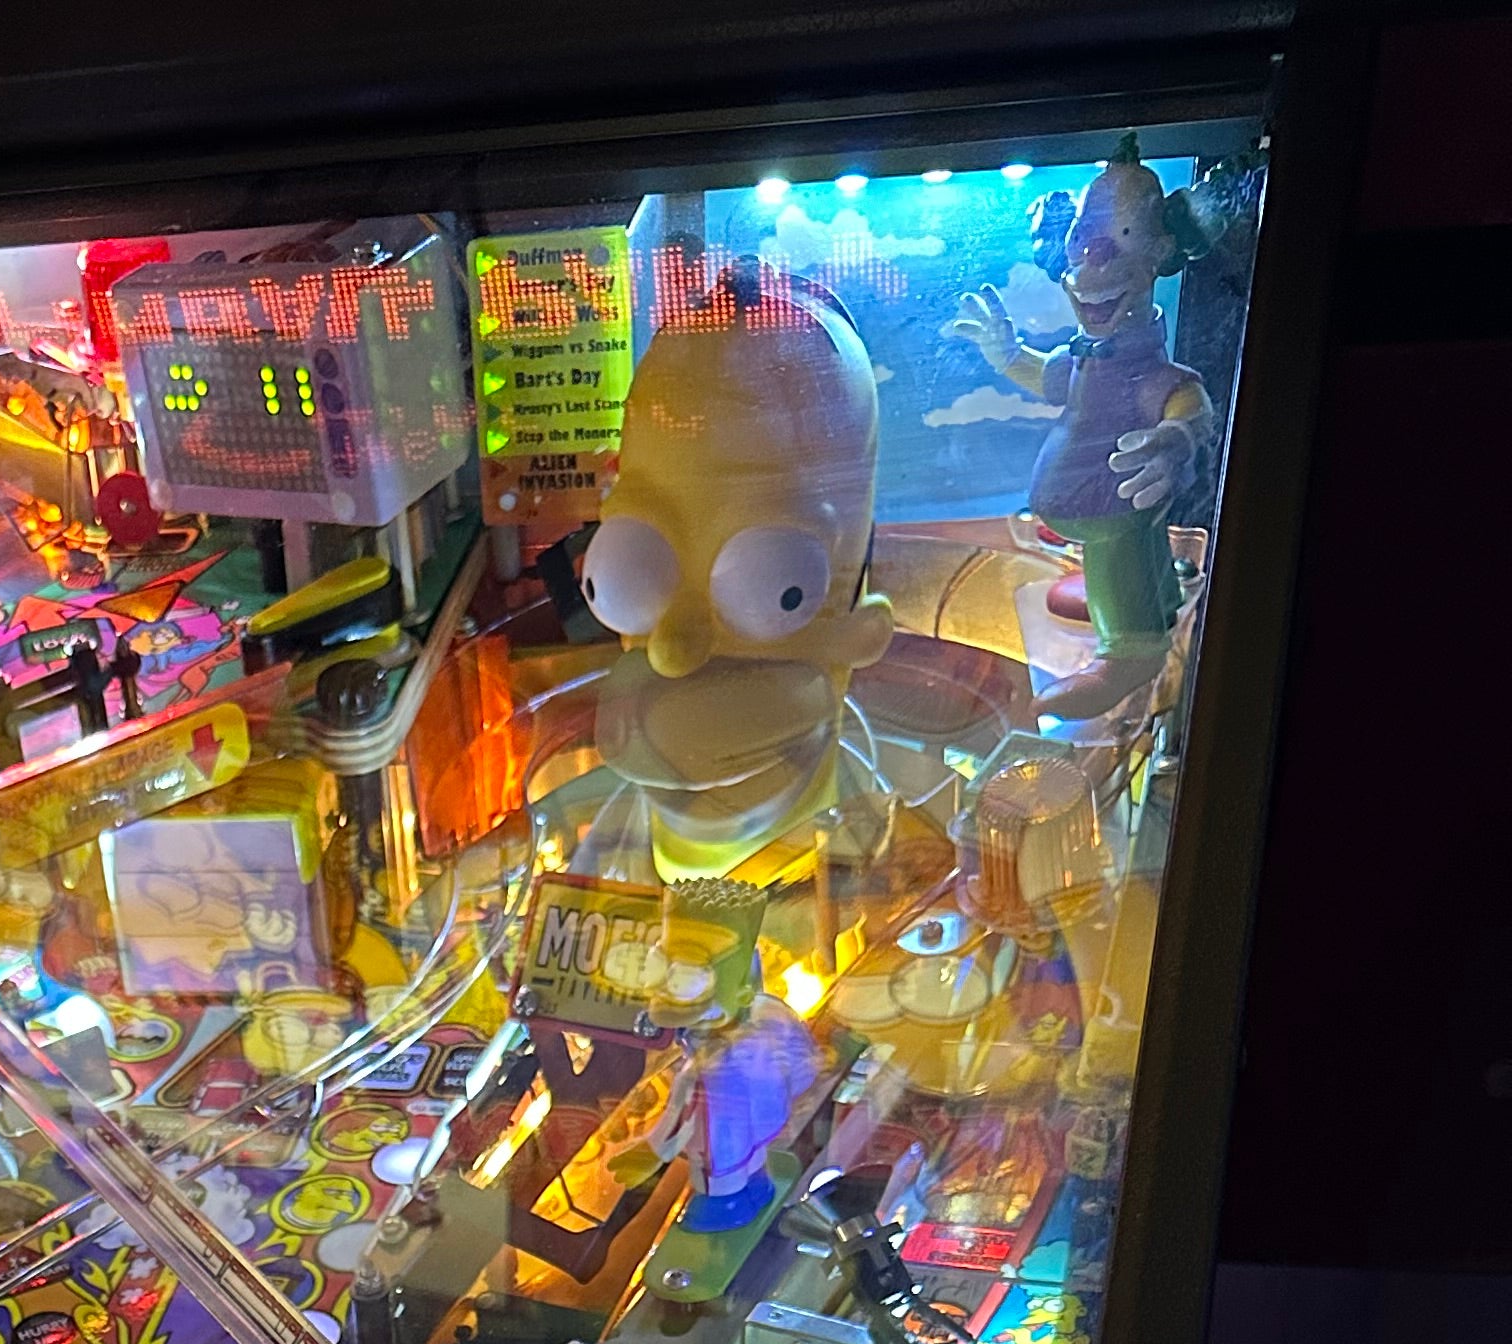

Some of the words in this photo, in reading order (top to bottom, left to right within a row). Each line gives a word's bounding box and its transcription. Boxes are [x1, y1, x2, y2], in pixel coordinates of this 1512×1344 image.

[588, 337, 628, 353] Snake
[514, 371, 565, 389] Bart's
[570, 368, 602, 388] Day
[528, 454, 578, 472] ALIEN
[518, 473, 596, 492] INVASION
